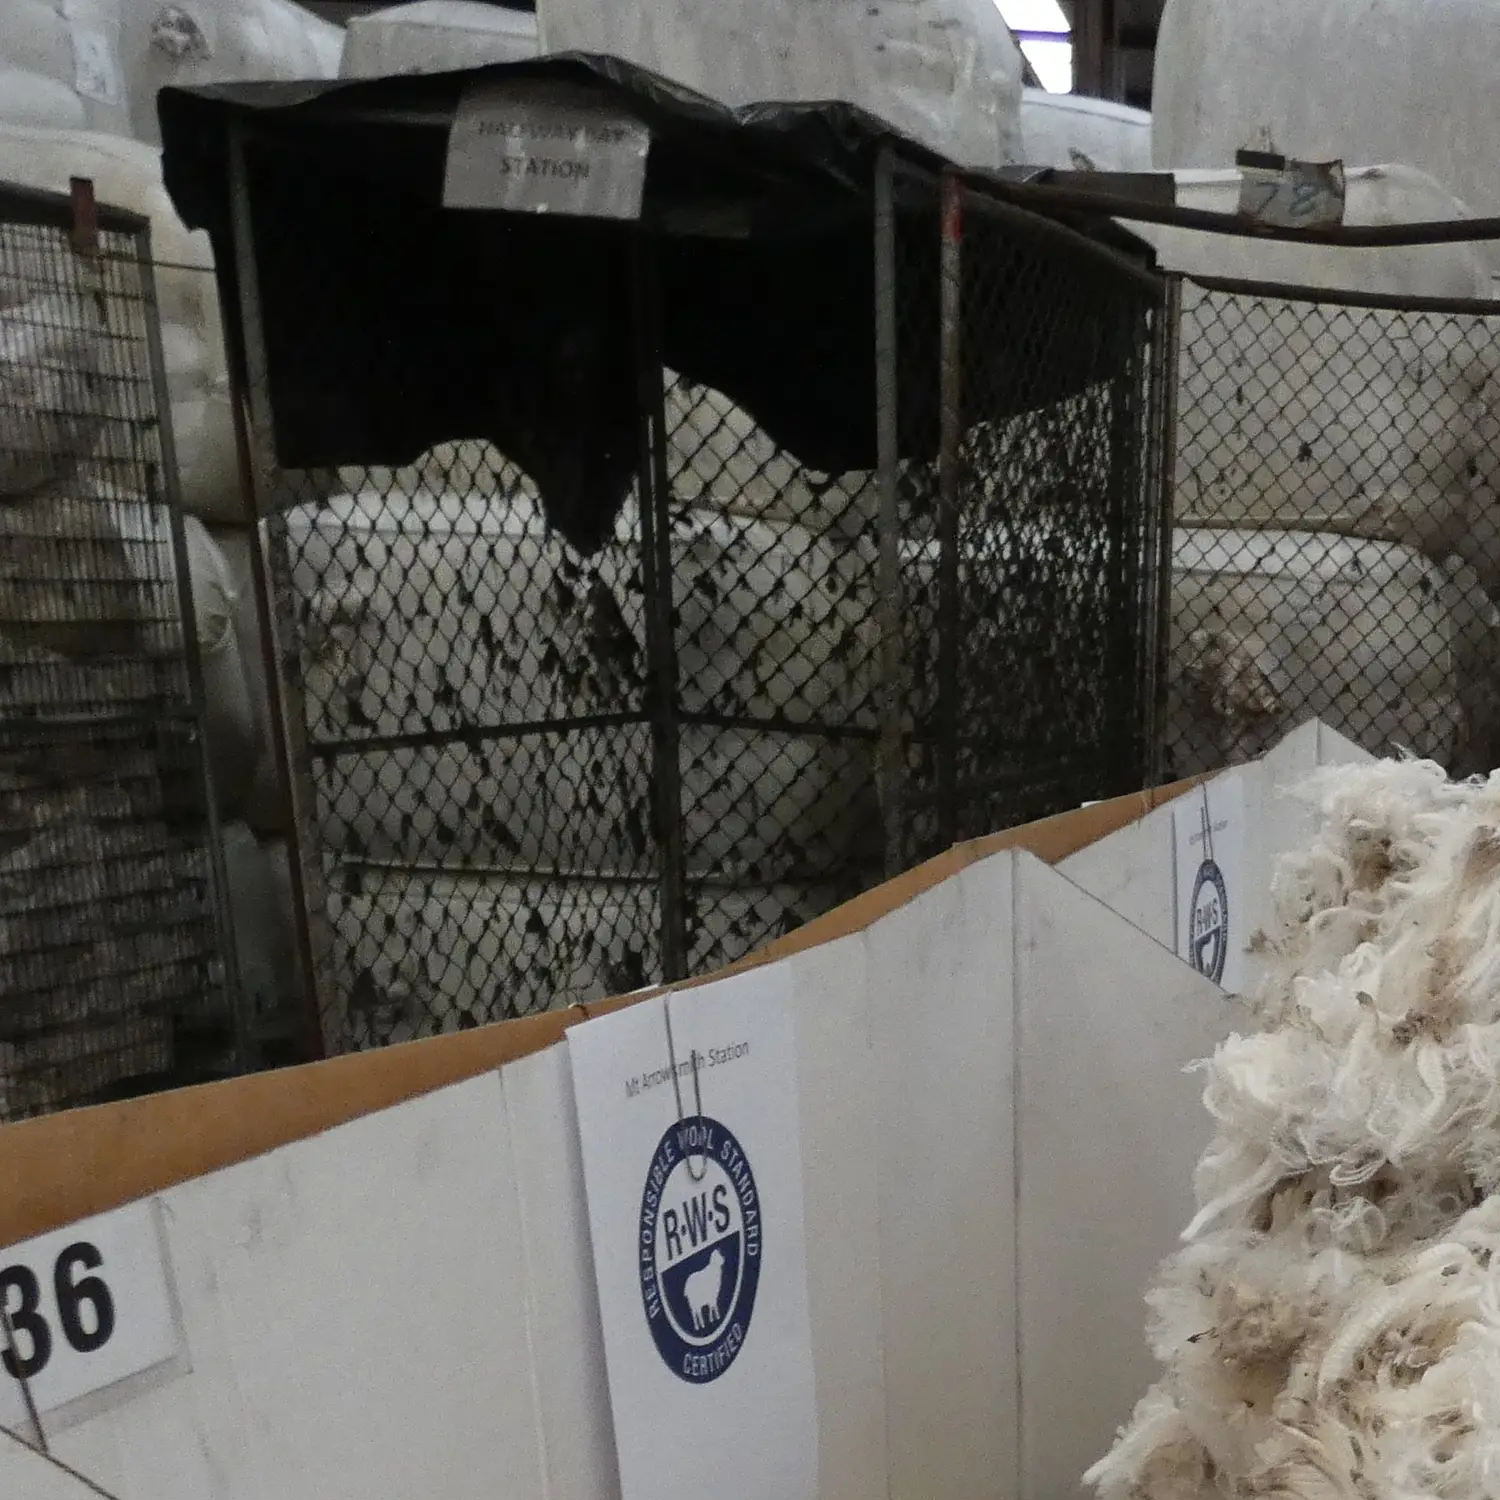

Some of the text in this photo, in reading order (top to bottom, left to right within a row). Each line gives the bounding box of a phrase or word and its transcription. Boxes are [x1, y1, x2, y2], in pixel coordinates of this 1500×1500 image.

[499, 156, 590, 179] STATION
[625, 1041, 749, 1098] Mt Arrowmih Station
[641, 1140, 676, 1319] RESPONSIBLE
[720, 1140, 760, 1257] STANDARD
[683, 1322, 743, 1377] CERTIFIED
